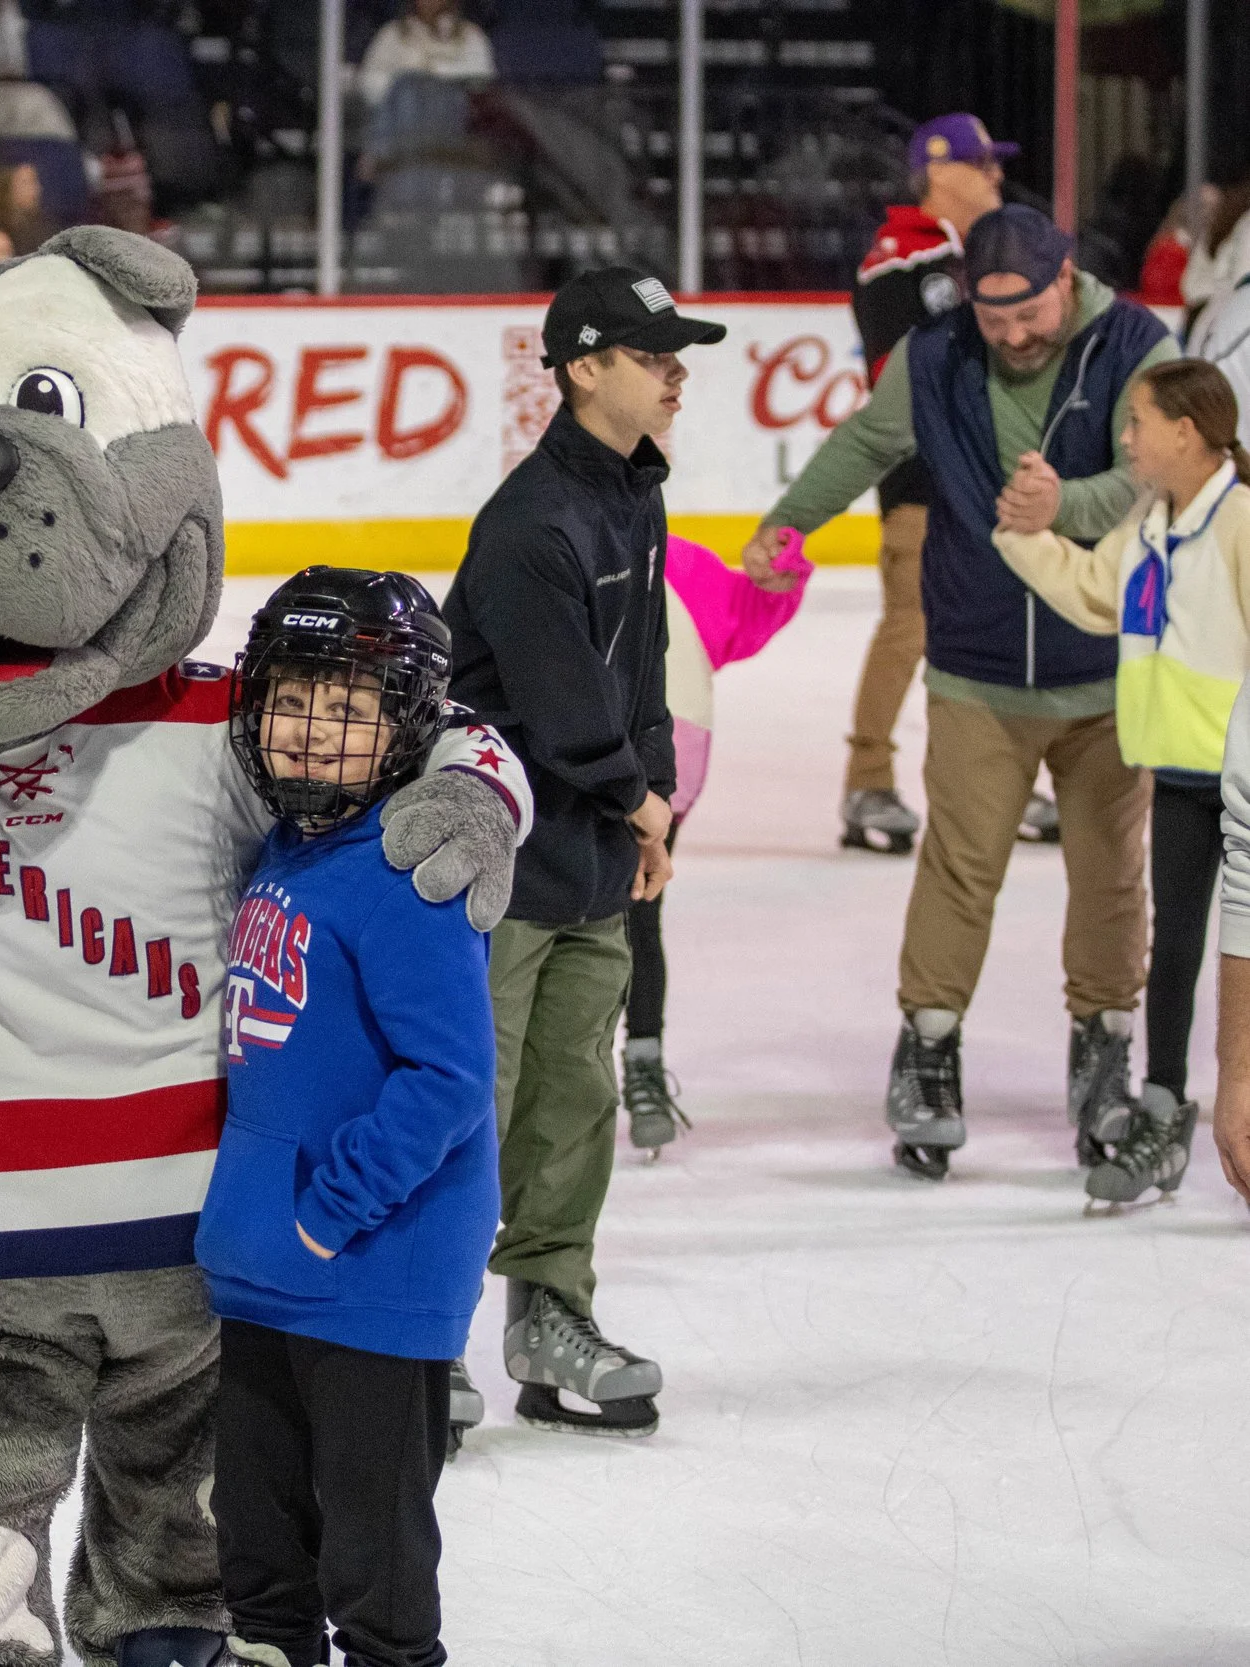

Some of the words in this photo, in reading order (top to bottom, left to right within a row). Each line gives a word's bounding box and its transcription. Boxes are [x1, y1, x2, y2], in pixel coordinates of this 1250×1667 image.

[205, 344, 468, 482] RED
[282, 613, 340, 629] CCM
[431, 652, 448, 667] CCM
[6, 812, 64, 827] CCM
[228, 897, 312, 1011] NGERS
